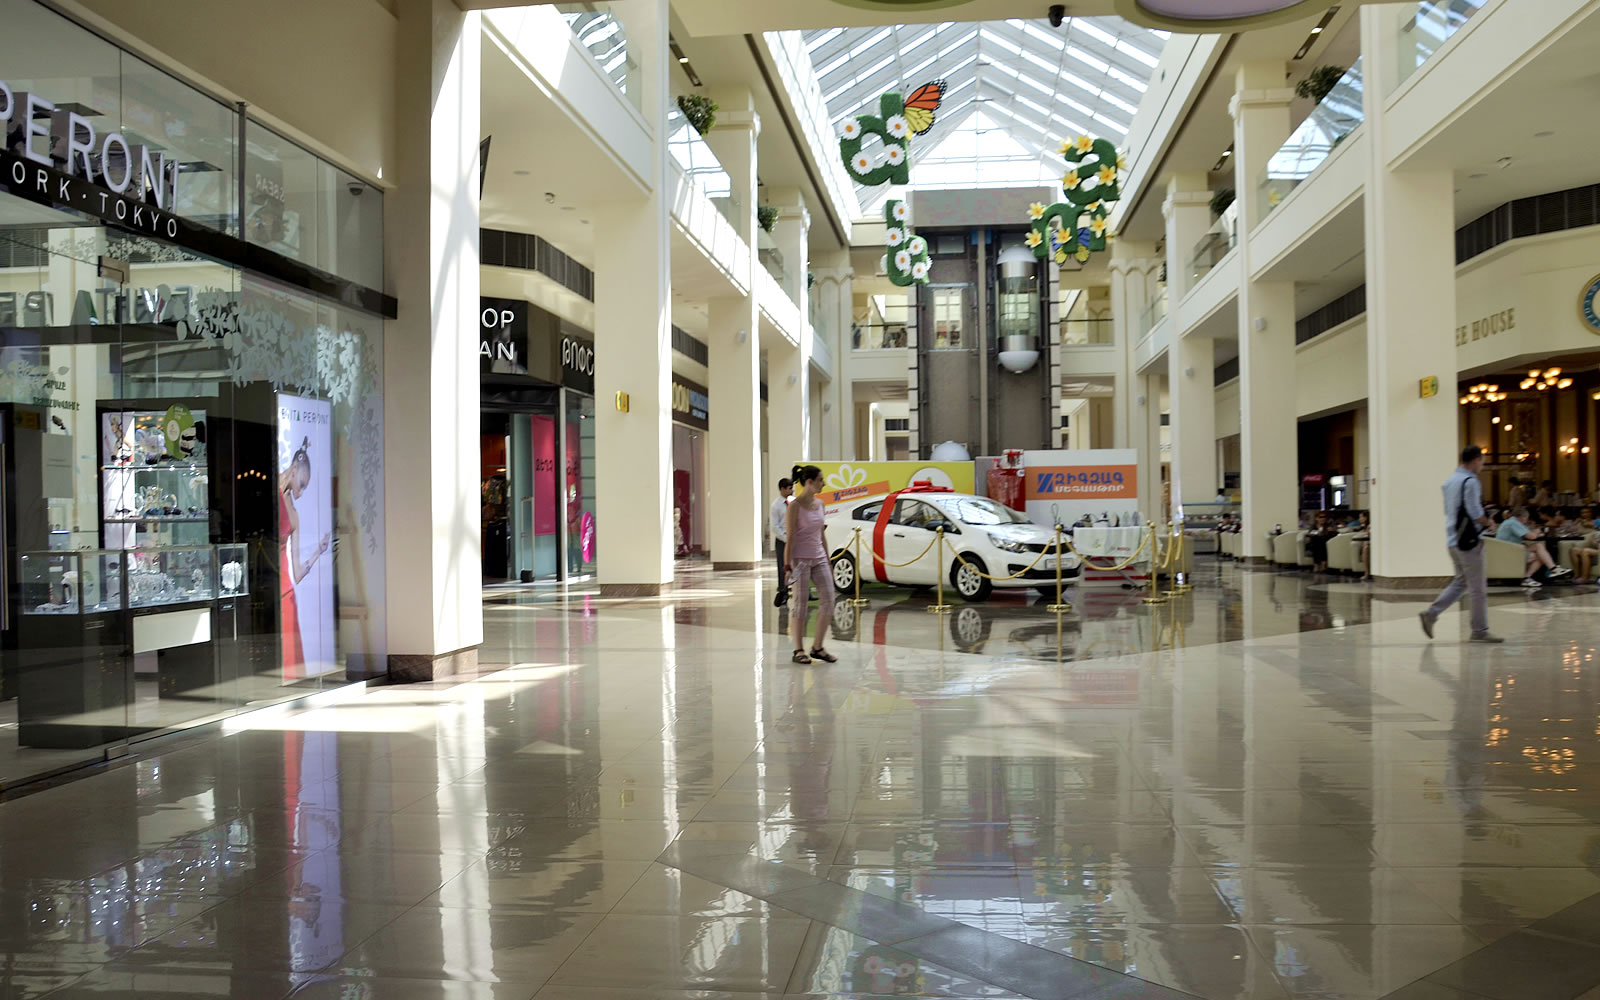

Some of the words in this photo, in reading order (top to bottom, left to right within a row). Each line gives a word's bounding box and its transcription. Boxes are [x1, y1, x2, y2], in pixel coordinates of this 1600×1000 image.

[12, 160, 71, 201] ORK
[99, 191, 177, 238] TOKYO
[481, 308, 514, 329] OP
[1472, 307, 1515, 342] HOUSE
[479, 340, 515, 360] AN
[1055, 471, 1124, 485] ԶԻԳԶԱԳ
